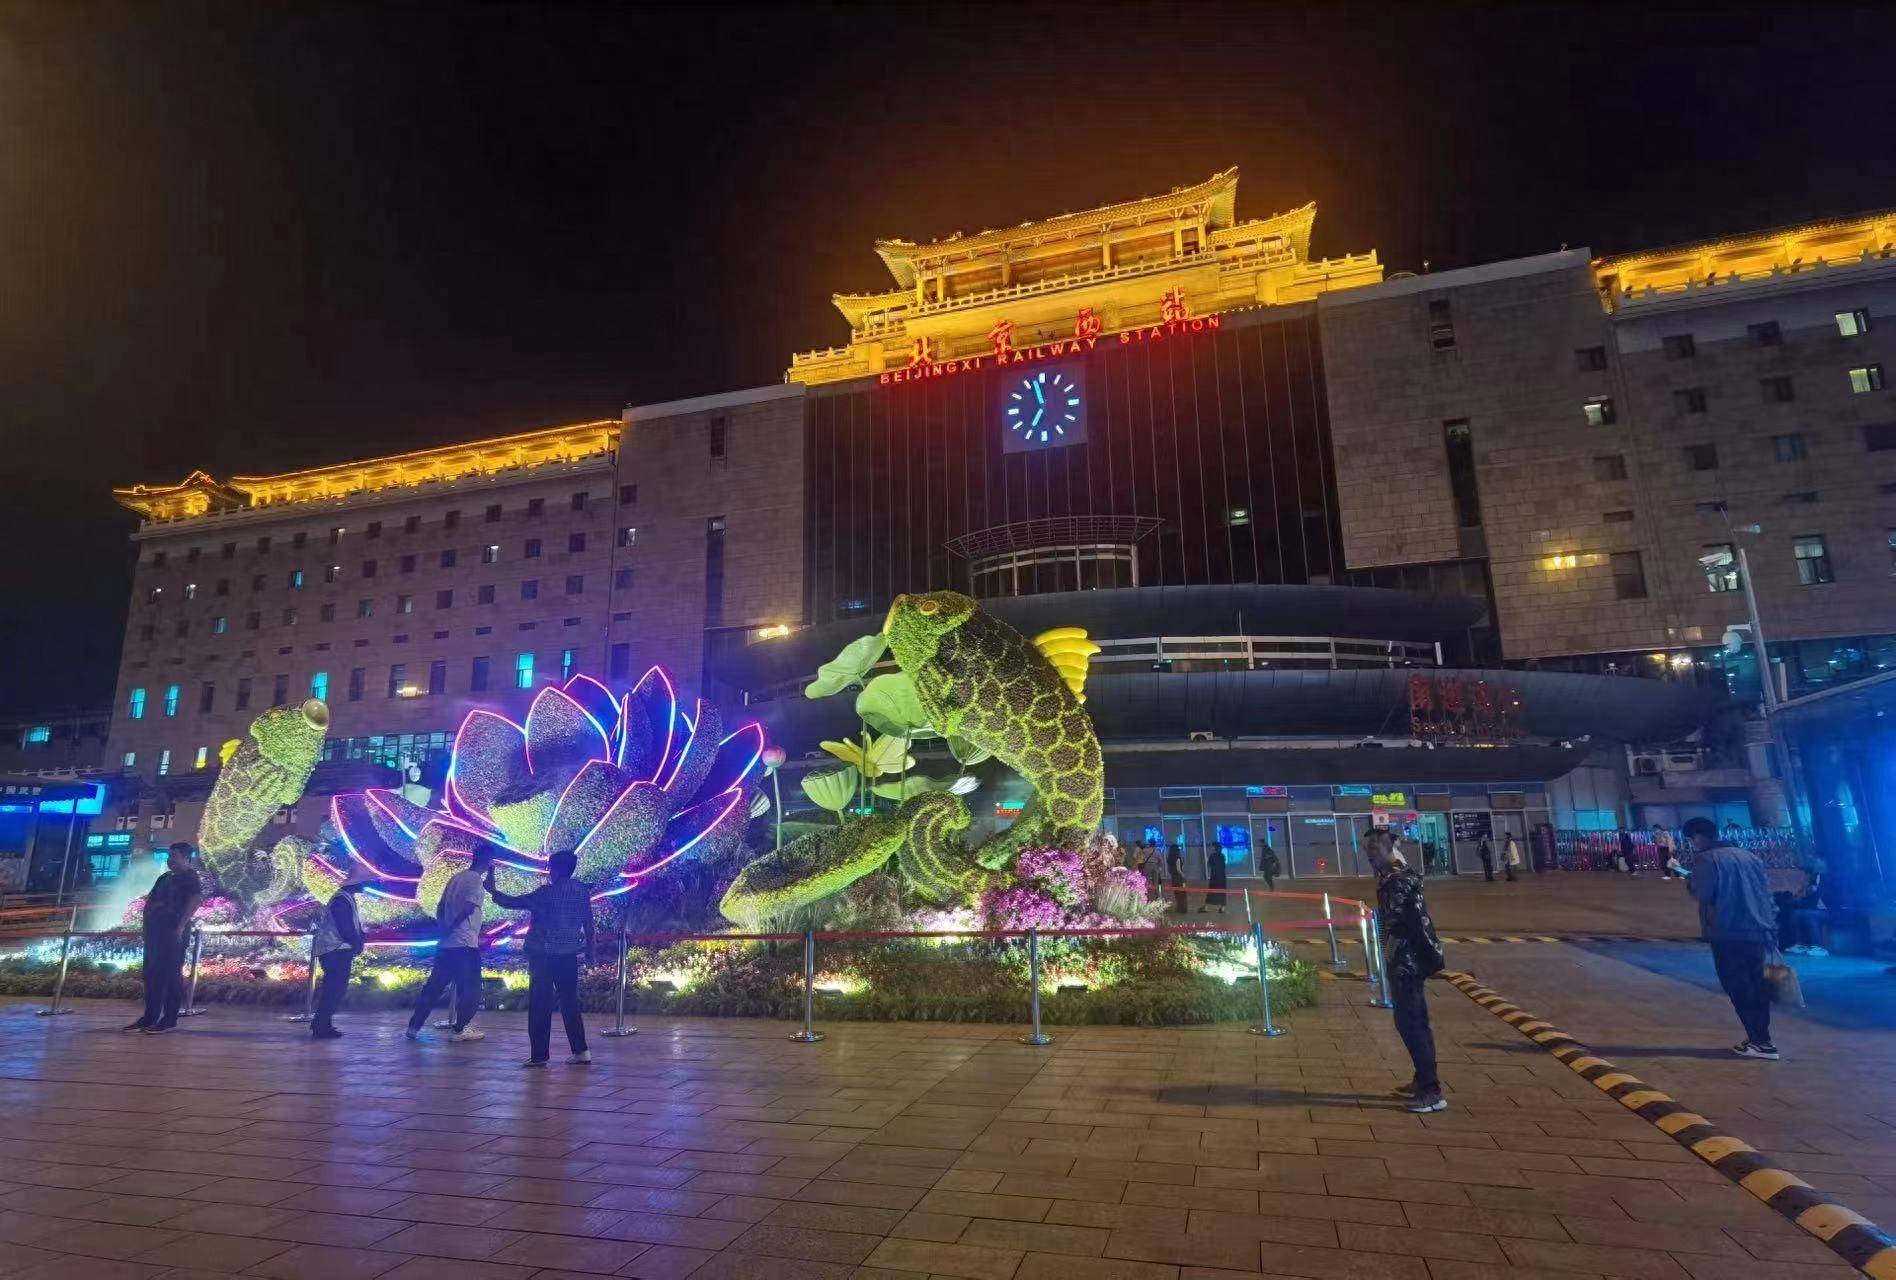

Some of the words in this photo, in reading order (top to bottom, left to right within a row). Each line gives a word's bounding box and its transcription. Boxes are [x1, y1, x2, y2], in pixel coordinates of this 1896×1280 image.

[880, 357, 981, 385] BEIJINGXI
[997, 337, 1097, 366] RAILWAY
[1119, 315, 1220, 345] STATION
[908, 285, 1190, 368] 北京西站
